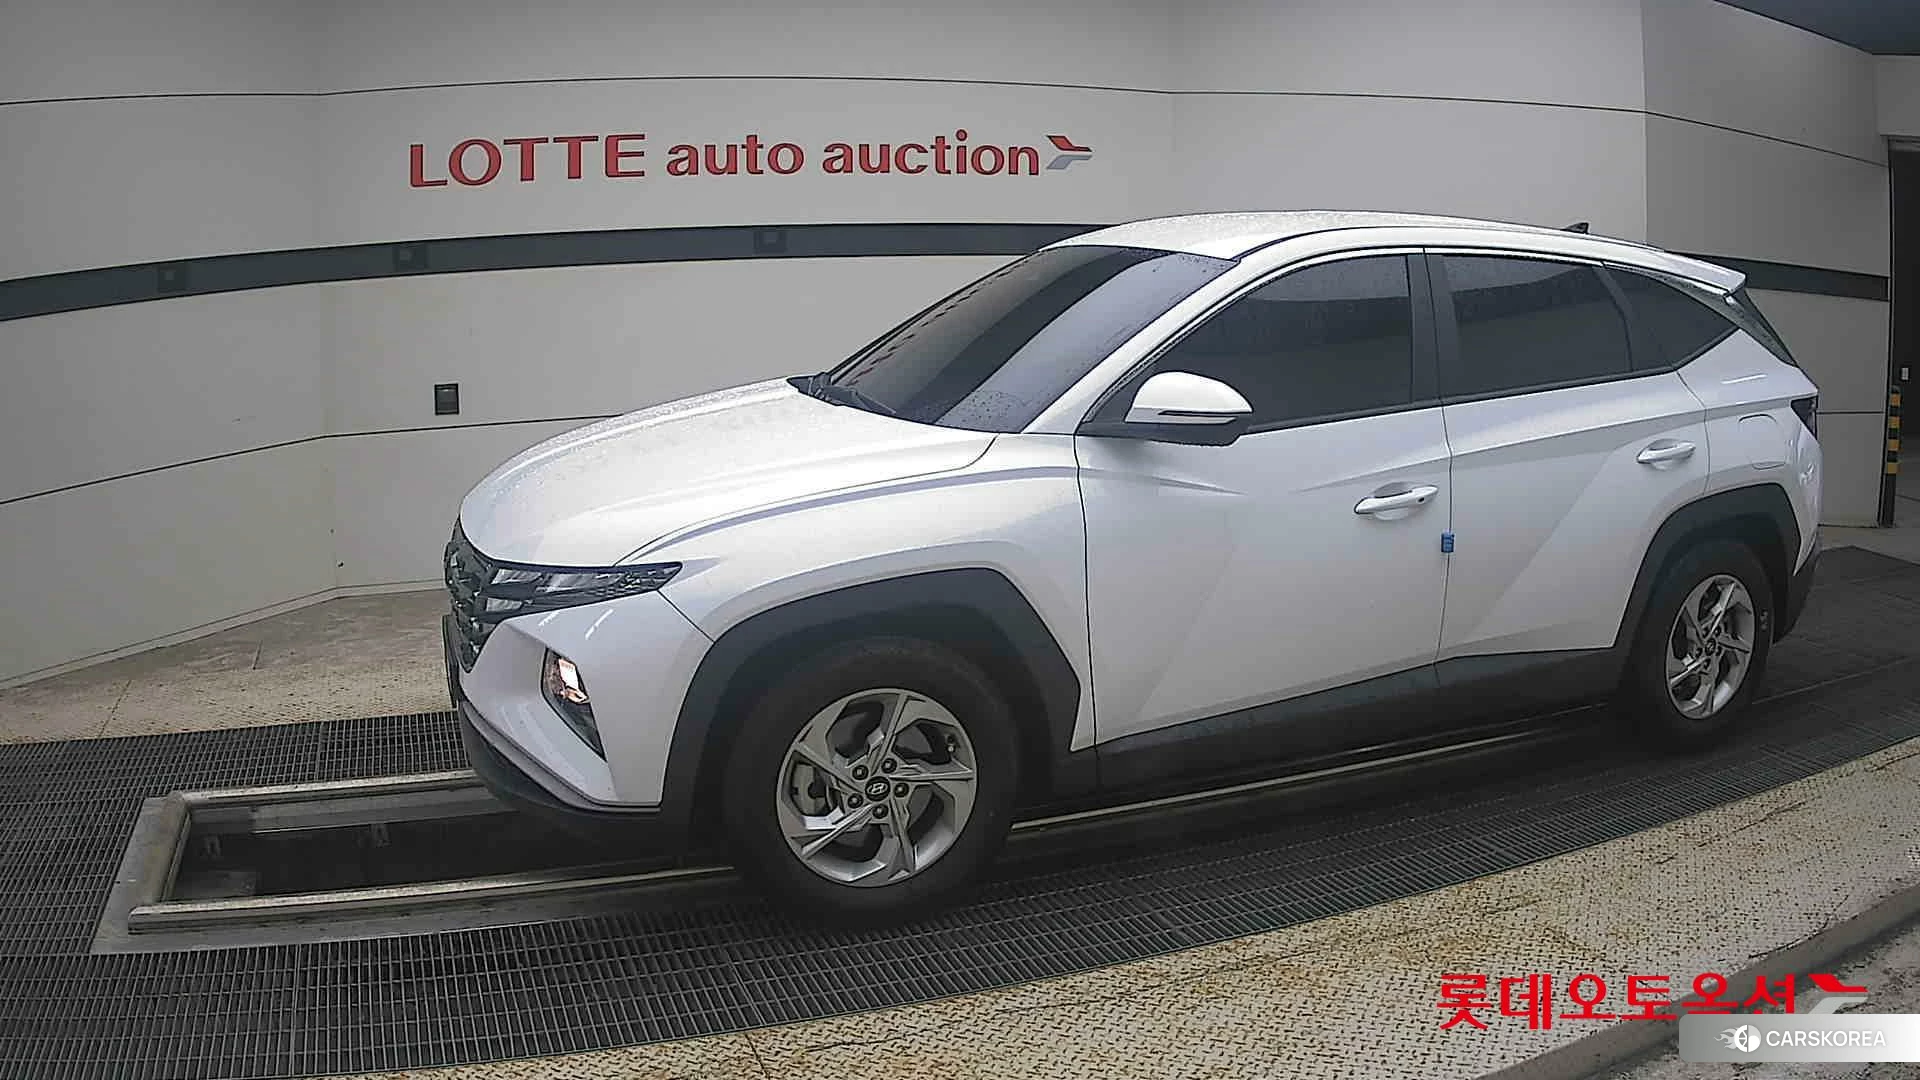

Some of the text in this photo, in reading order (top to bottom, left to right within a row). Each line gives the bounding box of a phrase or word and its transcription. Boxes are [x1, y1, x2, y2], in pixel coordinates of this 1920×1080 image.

[409, 128, 1040, 188] LOTTE auto auction
